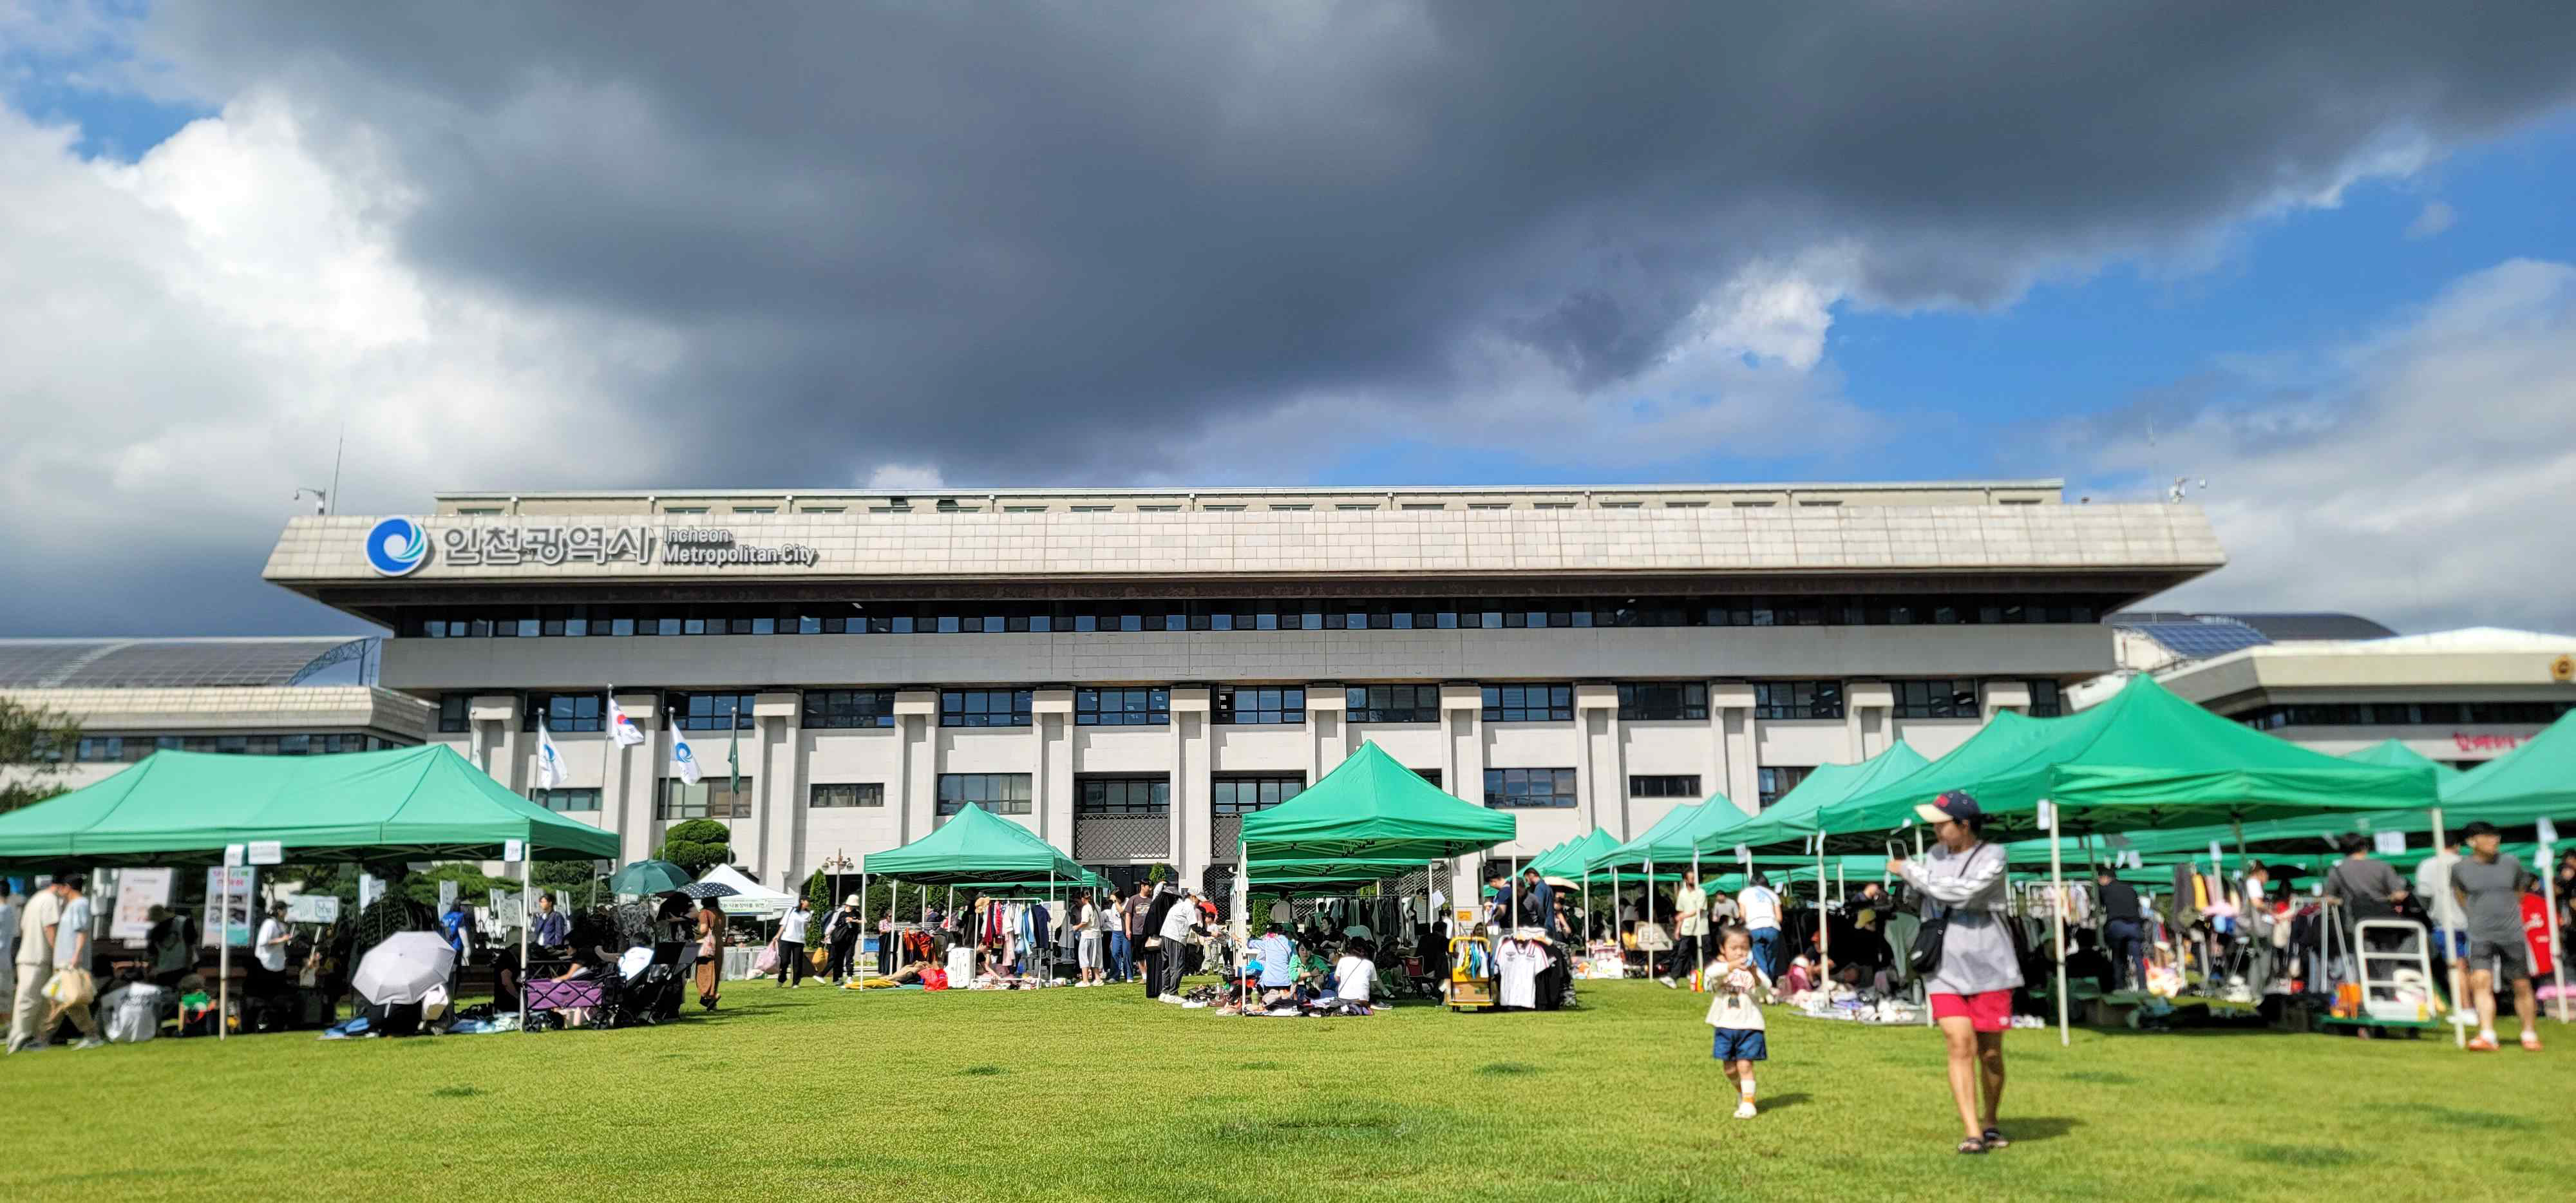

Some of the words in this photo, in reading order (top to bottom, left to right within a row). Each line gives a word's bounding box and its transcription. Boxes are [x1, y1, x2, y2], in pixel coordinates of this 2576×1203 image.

[444, 526, 649, 564] 인천광역시
[663, 526, 730, 543] Incheon
[661, 543, 779, 565] Metropolitan
[781, 543, 816, 565] City
